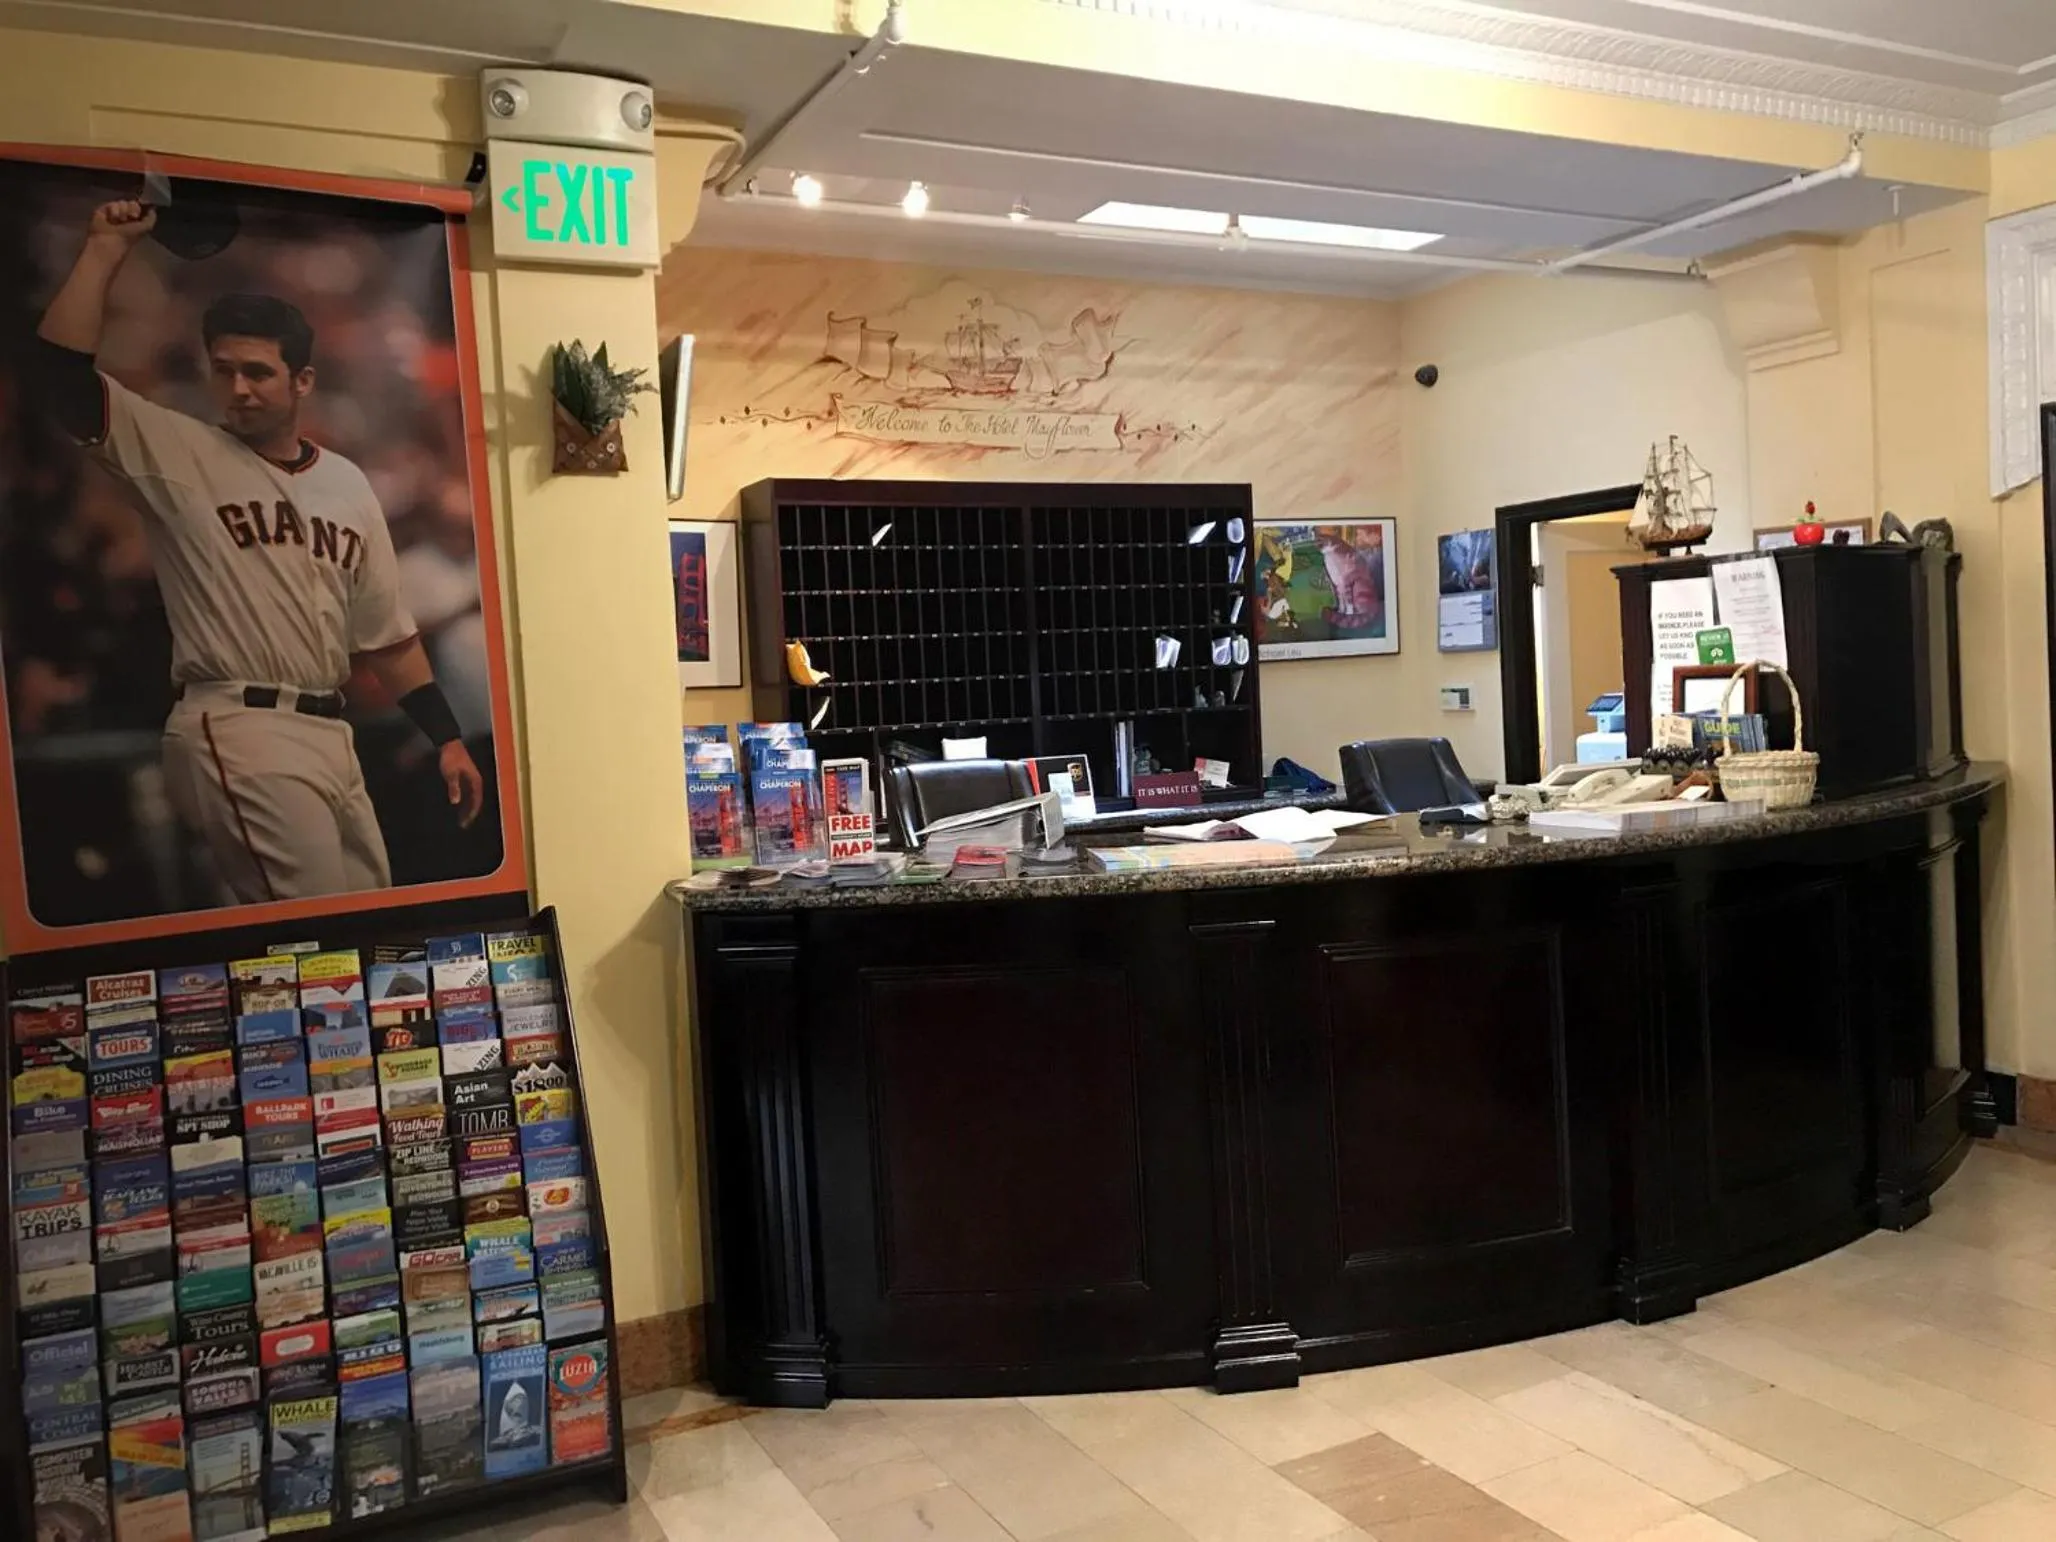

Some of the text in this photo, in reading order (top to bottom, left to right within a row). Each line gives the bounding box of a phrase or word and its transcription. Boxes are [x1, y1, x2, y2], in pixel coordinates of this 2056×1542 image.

[522, 159, 635, 247] EXIT
[855, 404, 929, 431] Welcome
[938, 413, 952, 434] to
[1704, 720, 1740, 734] GUDE
[1138, 785, 1198, 797] IT IS WHAT IT IS
[831, 815, 871, 832] FREE
[832, 841, 873, 858] MAP
[490, 938, 537, 950] TRAVEL
[99, 988, 143, 1000] Cruises
[100, 1038, 148, 1056] TOURS
[93, 1066, 152, 1086] DINING
[454, 1080, 488, 1096] Asian
[456, 1094, 476, 1105] Art
[33, 1105, 66, 1118] Bike
[255, 1102, 308, 1115] BALLPARK
[199, 1118, 231, 1130] SHOP
[264, 1112, 298, 1123] TOURS
[388, 1117, 445, 1134] Walking
[459, 1109, 509, 1136] TOMB
[396, 1144, 435, 1160] ZIP LINE
[18, 1203, 81, 1225] KAYAK
[21, 1216, 83, 1240] TRIPS
[190, 1320, 249, 1341] Tours
[29, 1340, 89, 1362] Official
[489, 1355, 545, 1371] SAILING
[559, 1359, 598, 1380] LUZIA
[276, 1400, 335, 1418] WHALE
[31, 1410, 98, 1432] CENTRAL
[41, 1423, 89, 1441] COAST
